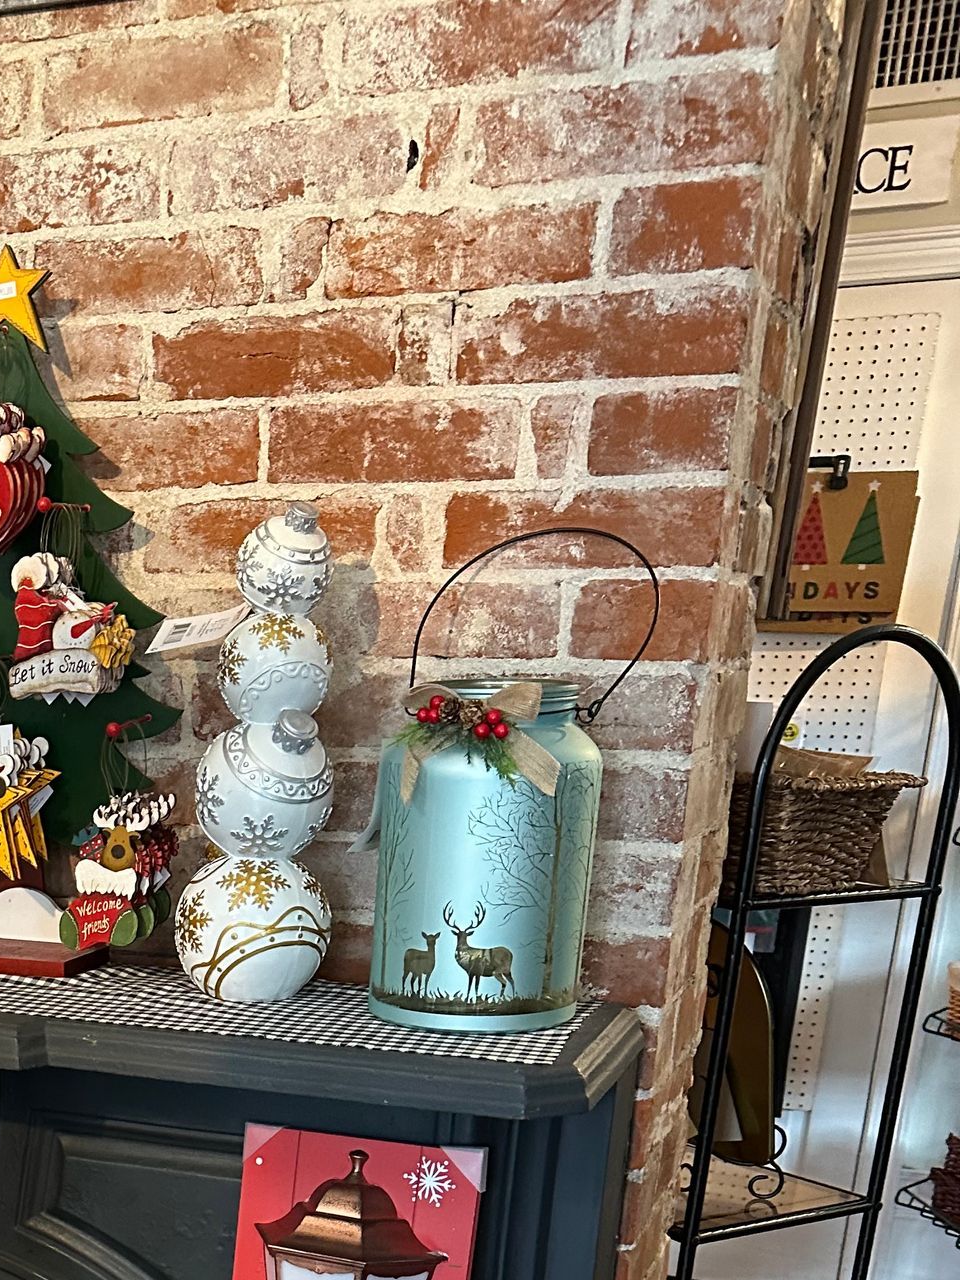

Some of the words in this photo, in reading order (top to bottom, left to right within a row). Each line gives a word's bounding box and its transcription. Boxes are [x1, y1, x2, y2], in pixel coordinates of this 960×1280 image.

[853, 144, 914, 195] CE
[11, 664, 36, 685] Let
[41, 658, 54, 676] it
[59, 654, 98, 674] Snow
[76, 898, 124, 917] Welcome
[81, 914, 110, 941] friends
